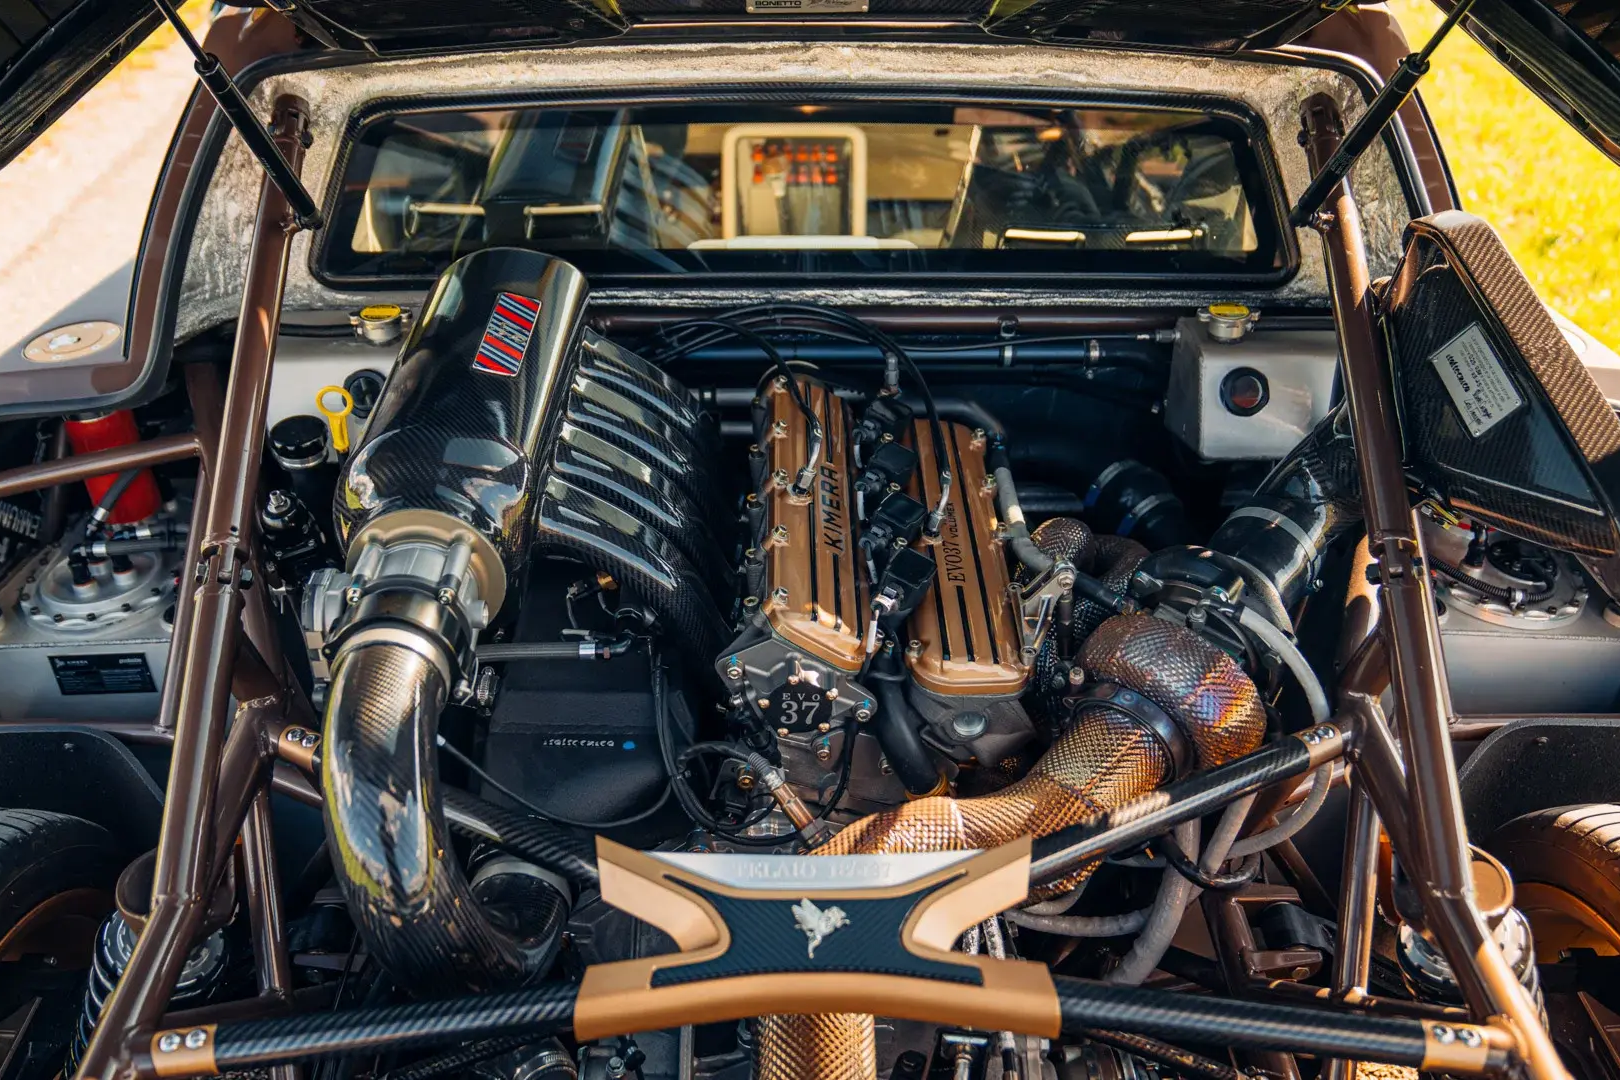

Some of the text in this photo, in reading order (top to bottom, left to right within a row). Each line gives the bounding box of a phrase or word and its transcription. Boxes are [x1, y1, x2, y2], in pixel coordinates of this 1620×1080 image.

[820, 466, 844, 551] KIMERA
[942, 541, 966, 583] EVO37
[780, 701, 820, 725] 37
[782, 692, 820, 701] EVO
